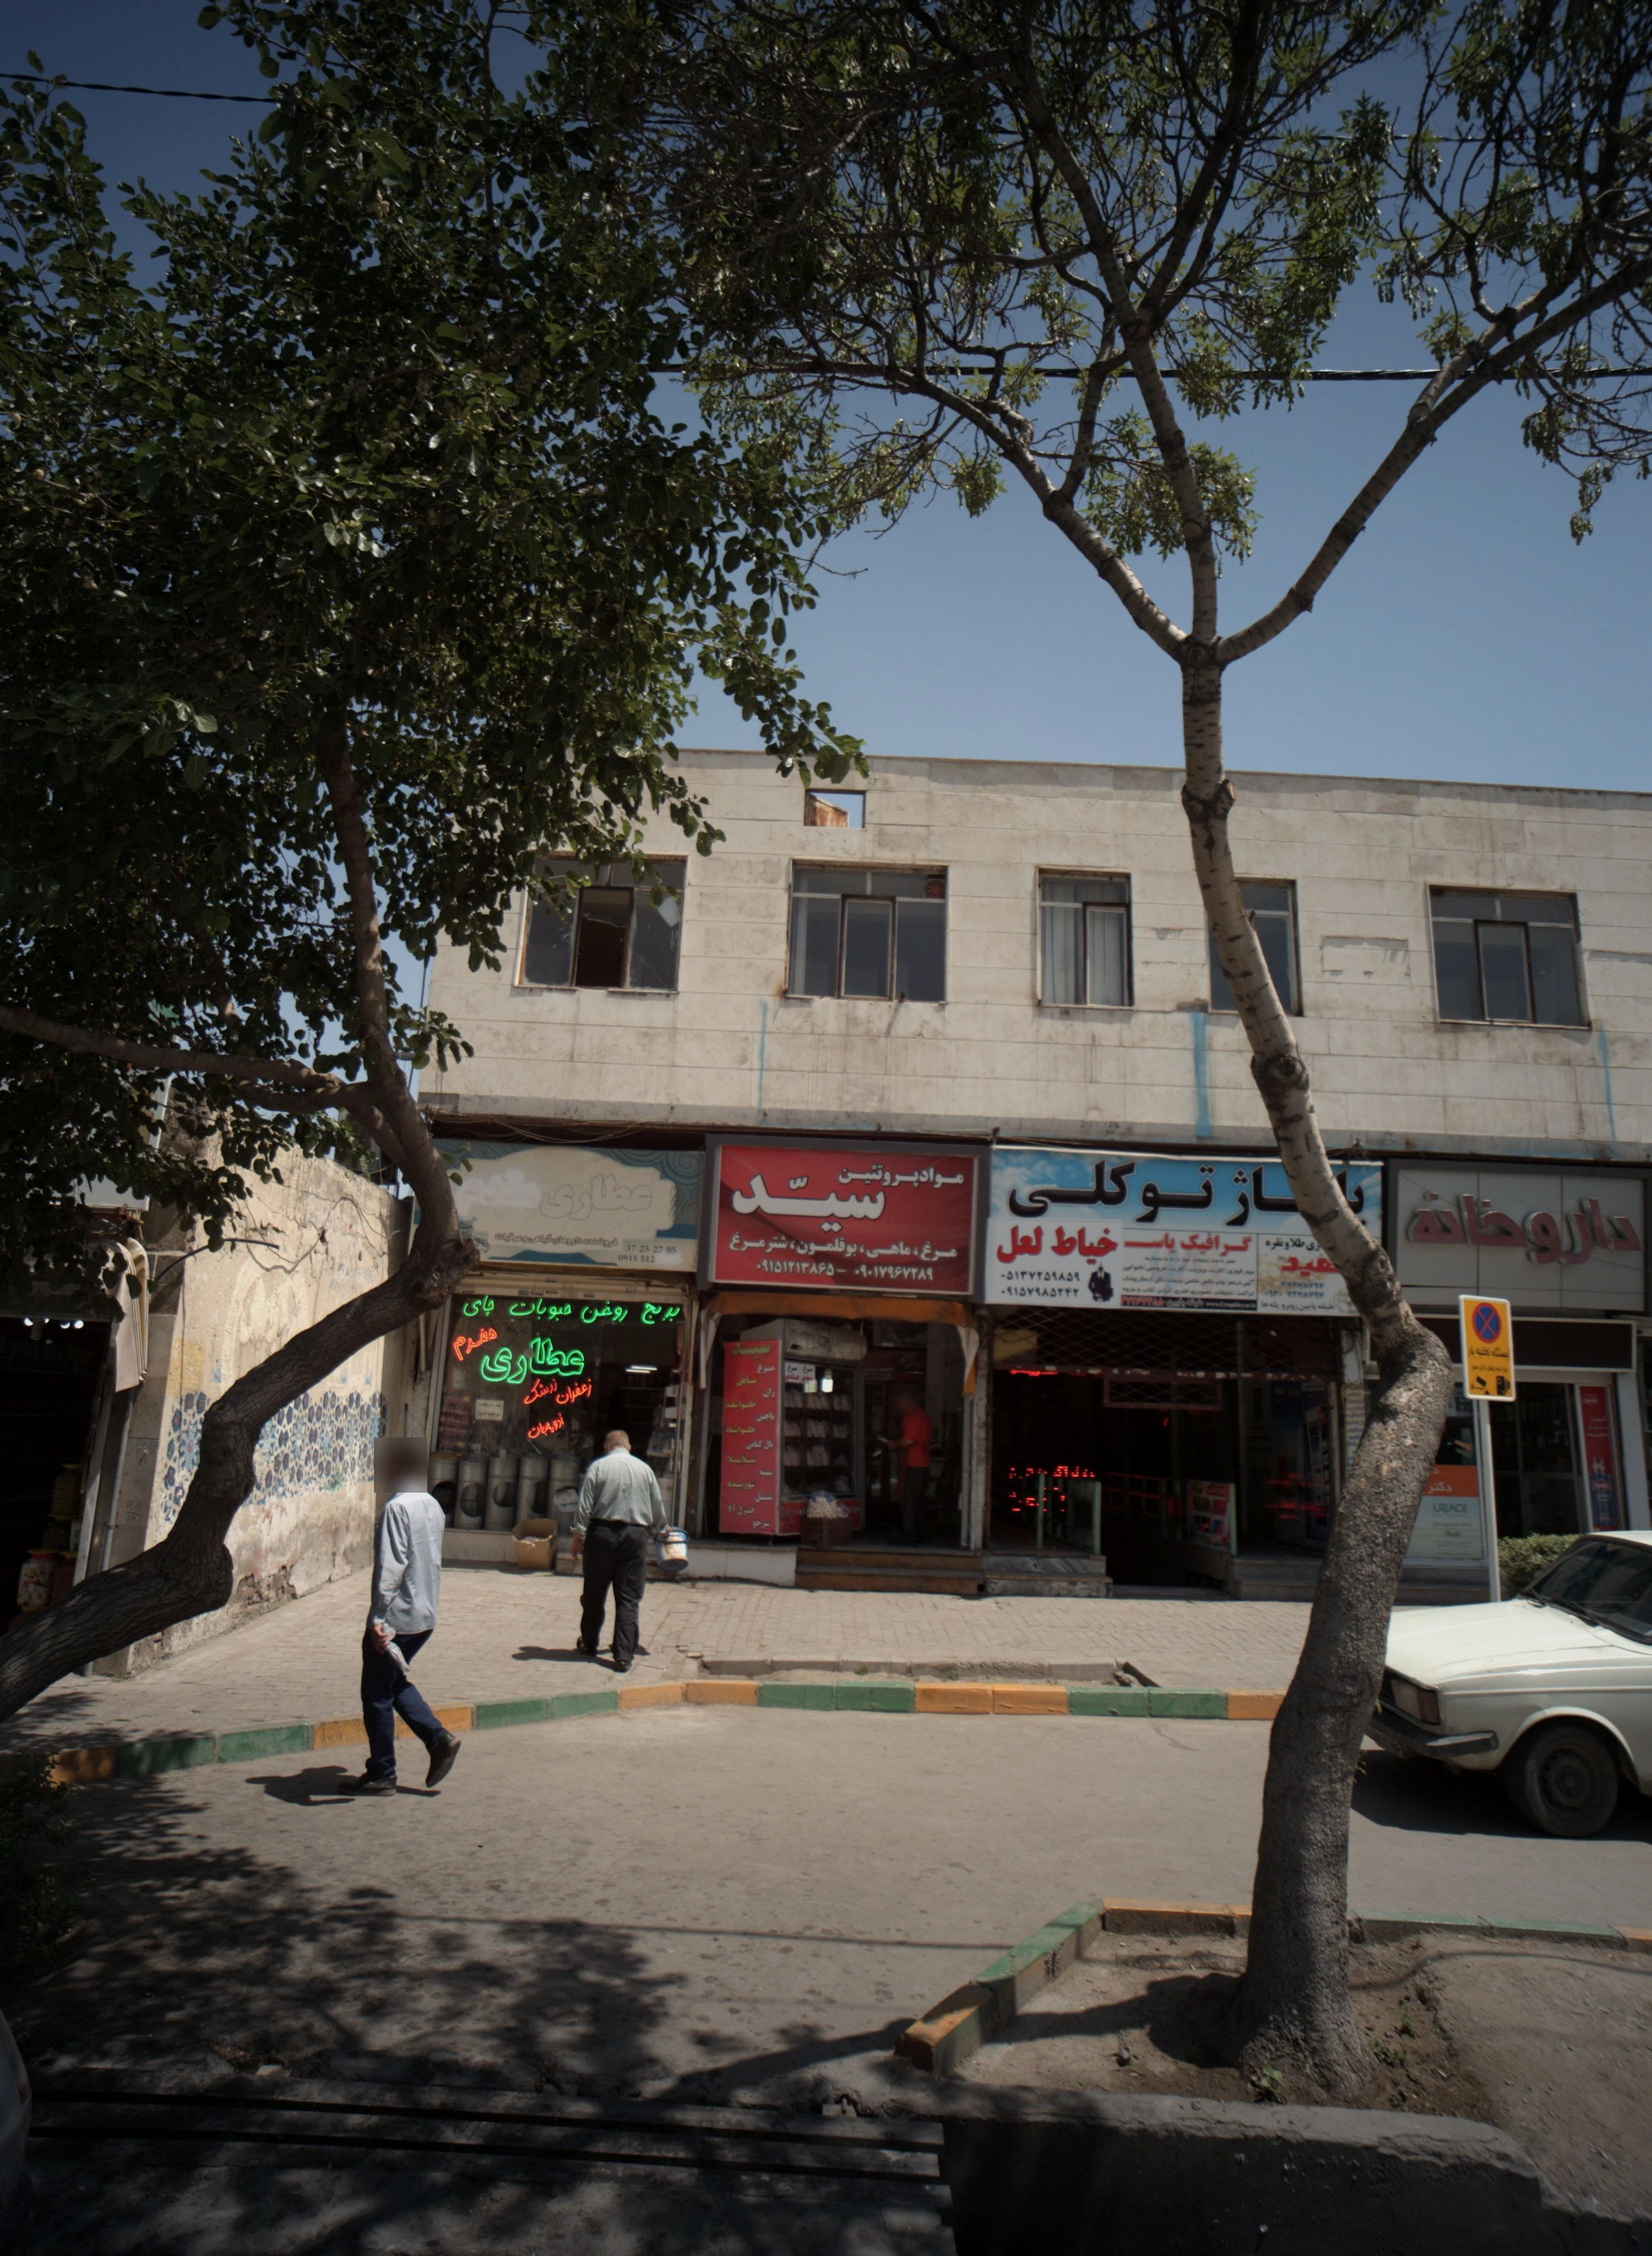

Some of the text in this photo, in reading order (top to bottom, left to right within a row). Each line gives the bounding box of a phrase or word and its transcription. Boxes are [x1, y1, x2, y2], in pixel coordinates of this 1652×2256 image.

[839, 1164, 964, 1189] مواد پروتئین
[540, 1174, 653, 1220] عطاری
[1008, 1159, 1366, 1227] پااژ توکلی
[1408, 1191, 1642, 1266] داروخانه
[997, 1225, 1118, 1265] خیاط لعل
[1181, 1233, 1252, 1257] گرافیک
[509, 1298, 572, 1321] حبوبات
[580, 1300, 628, 1324] روغن
[481, 1337, 585, 1384] عطاری
[757, 1363, 776, 1375] مرغ
[736, 1376, 758, 1387] ماهی
[763, 1387, 776, 1398] ران
[1433, 1503, 1469, 1514] URIAGE
